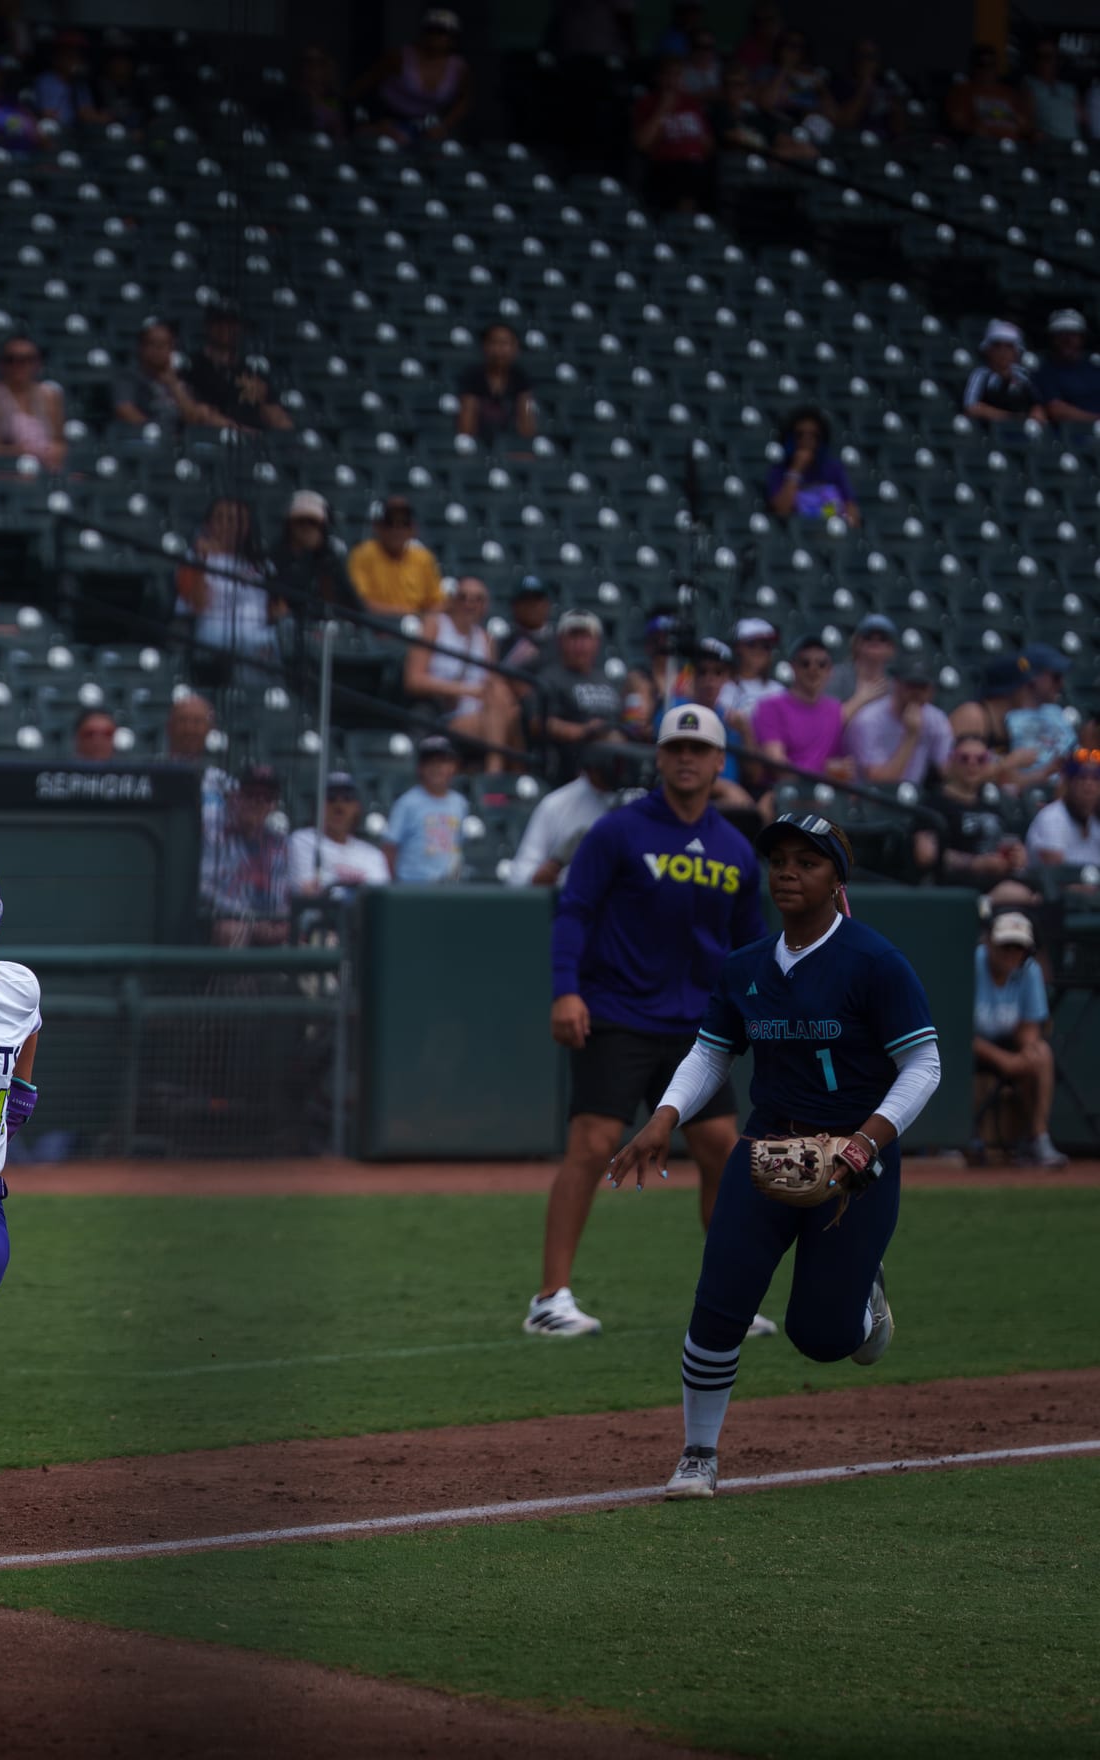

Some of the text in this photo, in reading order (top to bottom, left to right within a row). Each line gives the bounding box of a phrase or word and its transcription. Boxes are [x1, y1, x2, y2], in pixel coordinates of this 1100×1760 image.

[35, 770, 153, 800] SEPHORA
[642, 852, 741, 894] VOLTS
[747, 1018, 842, 1040] ORTLAND
[815, 1047, 838, 1092] 1
